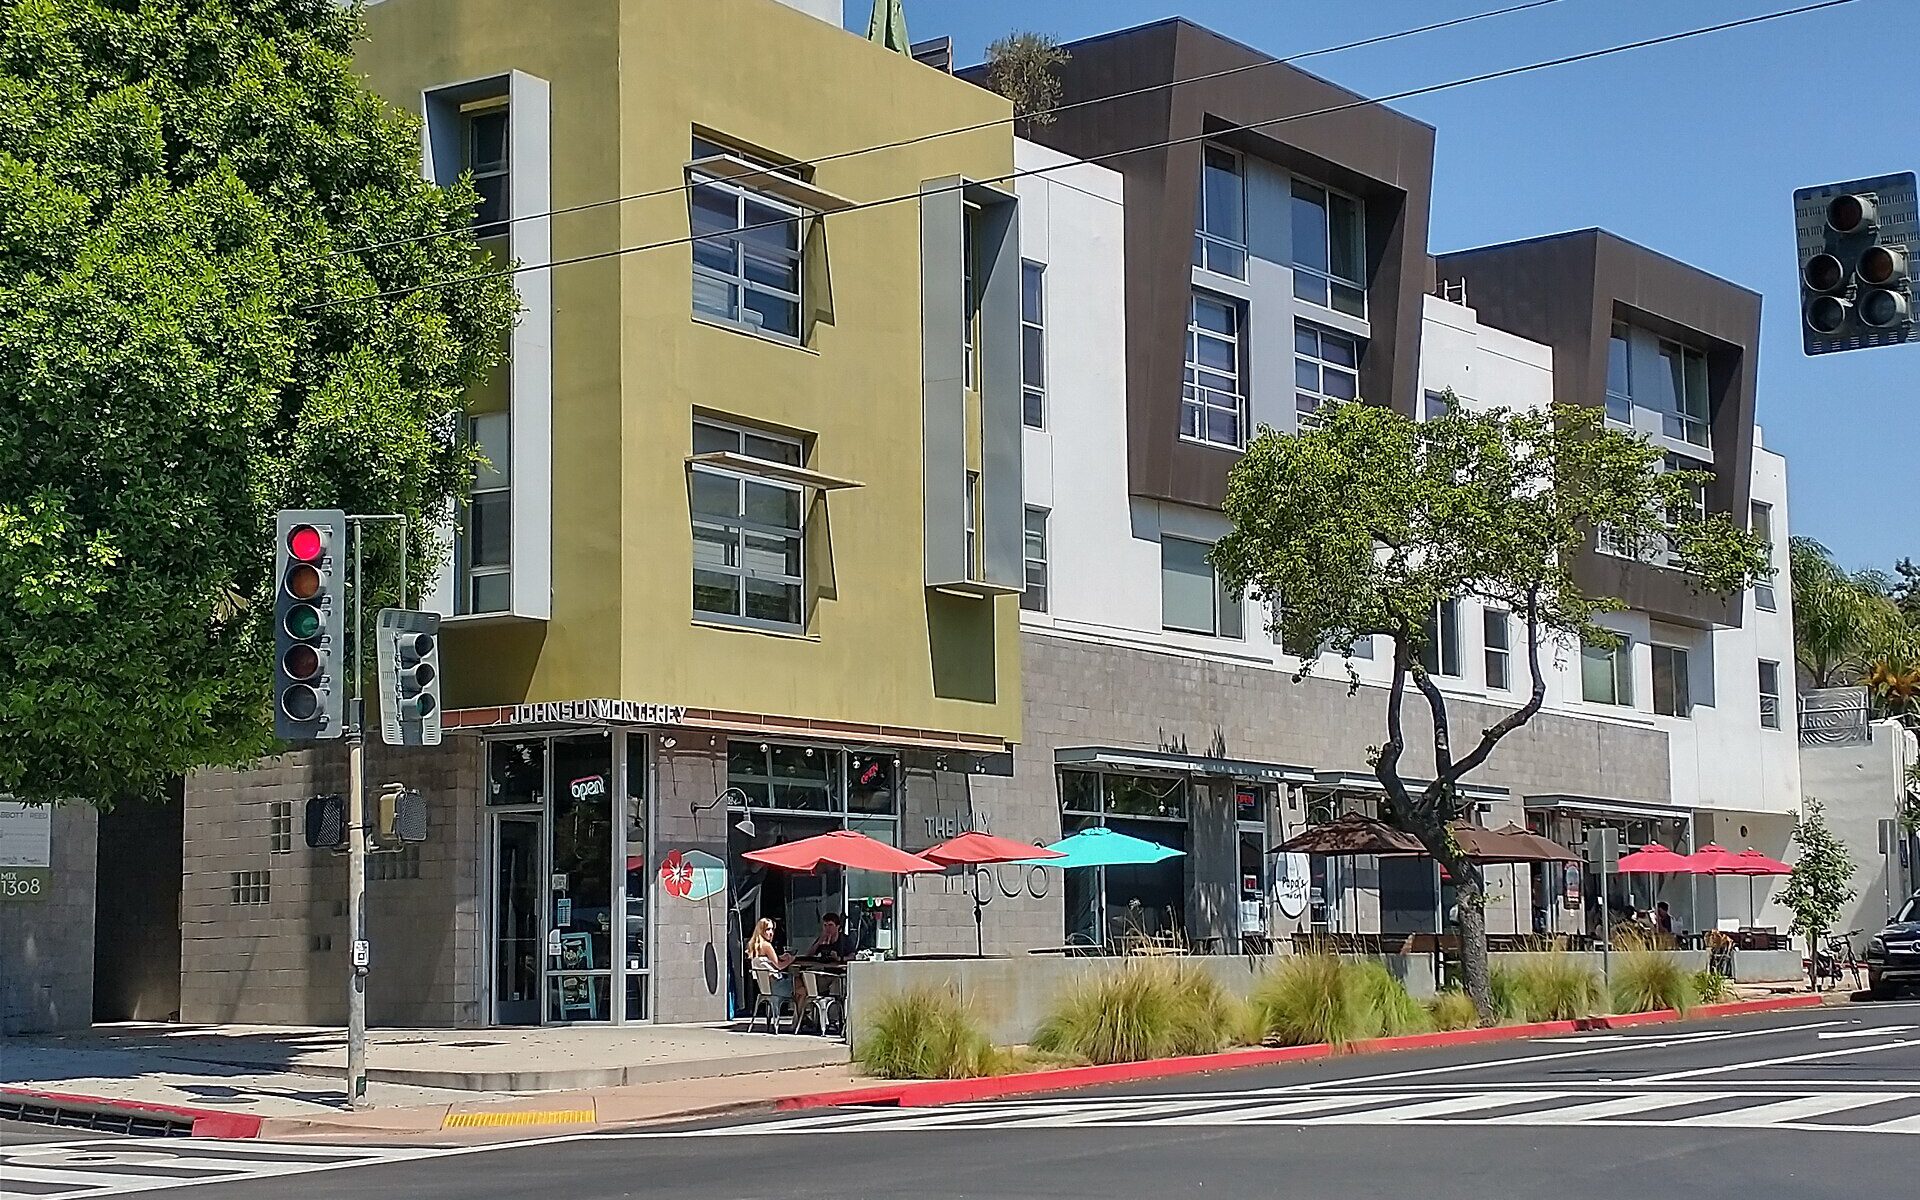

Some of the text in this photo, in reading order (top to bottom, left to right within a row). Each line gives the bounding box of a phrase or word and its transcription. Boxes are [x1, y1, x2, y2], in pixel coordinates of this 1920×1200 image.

[571, 779, 605, 800] open
[925, 816, 954, 839] THE
[1, 872, 17, 880] MIX
[1, 878, 41, 896] 1308
